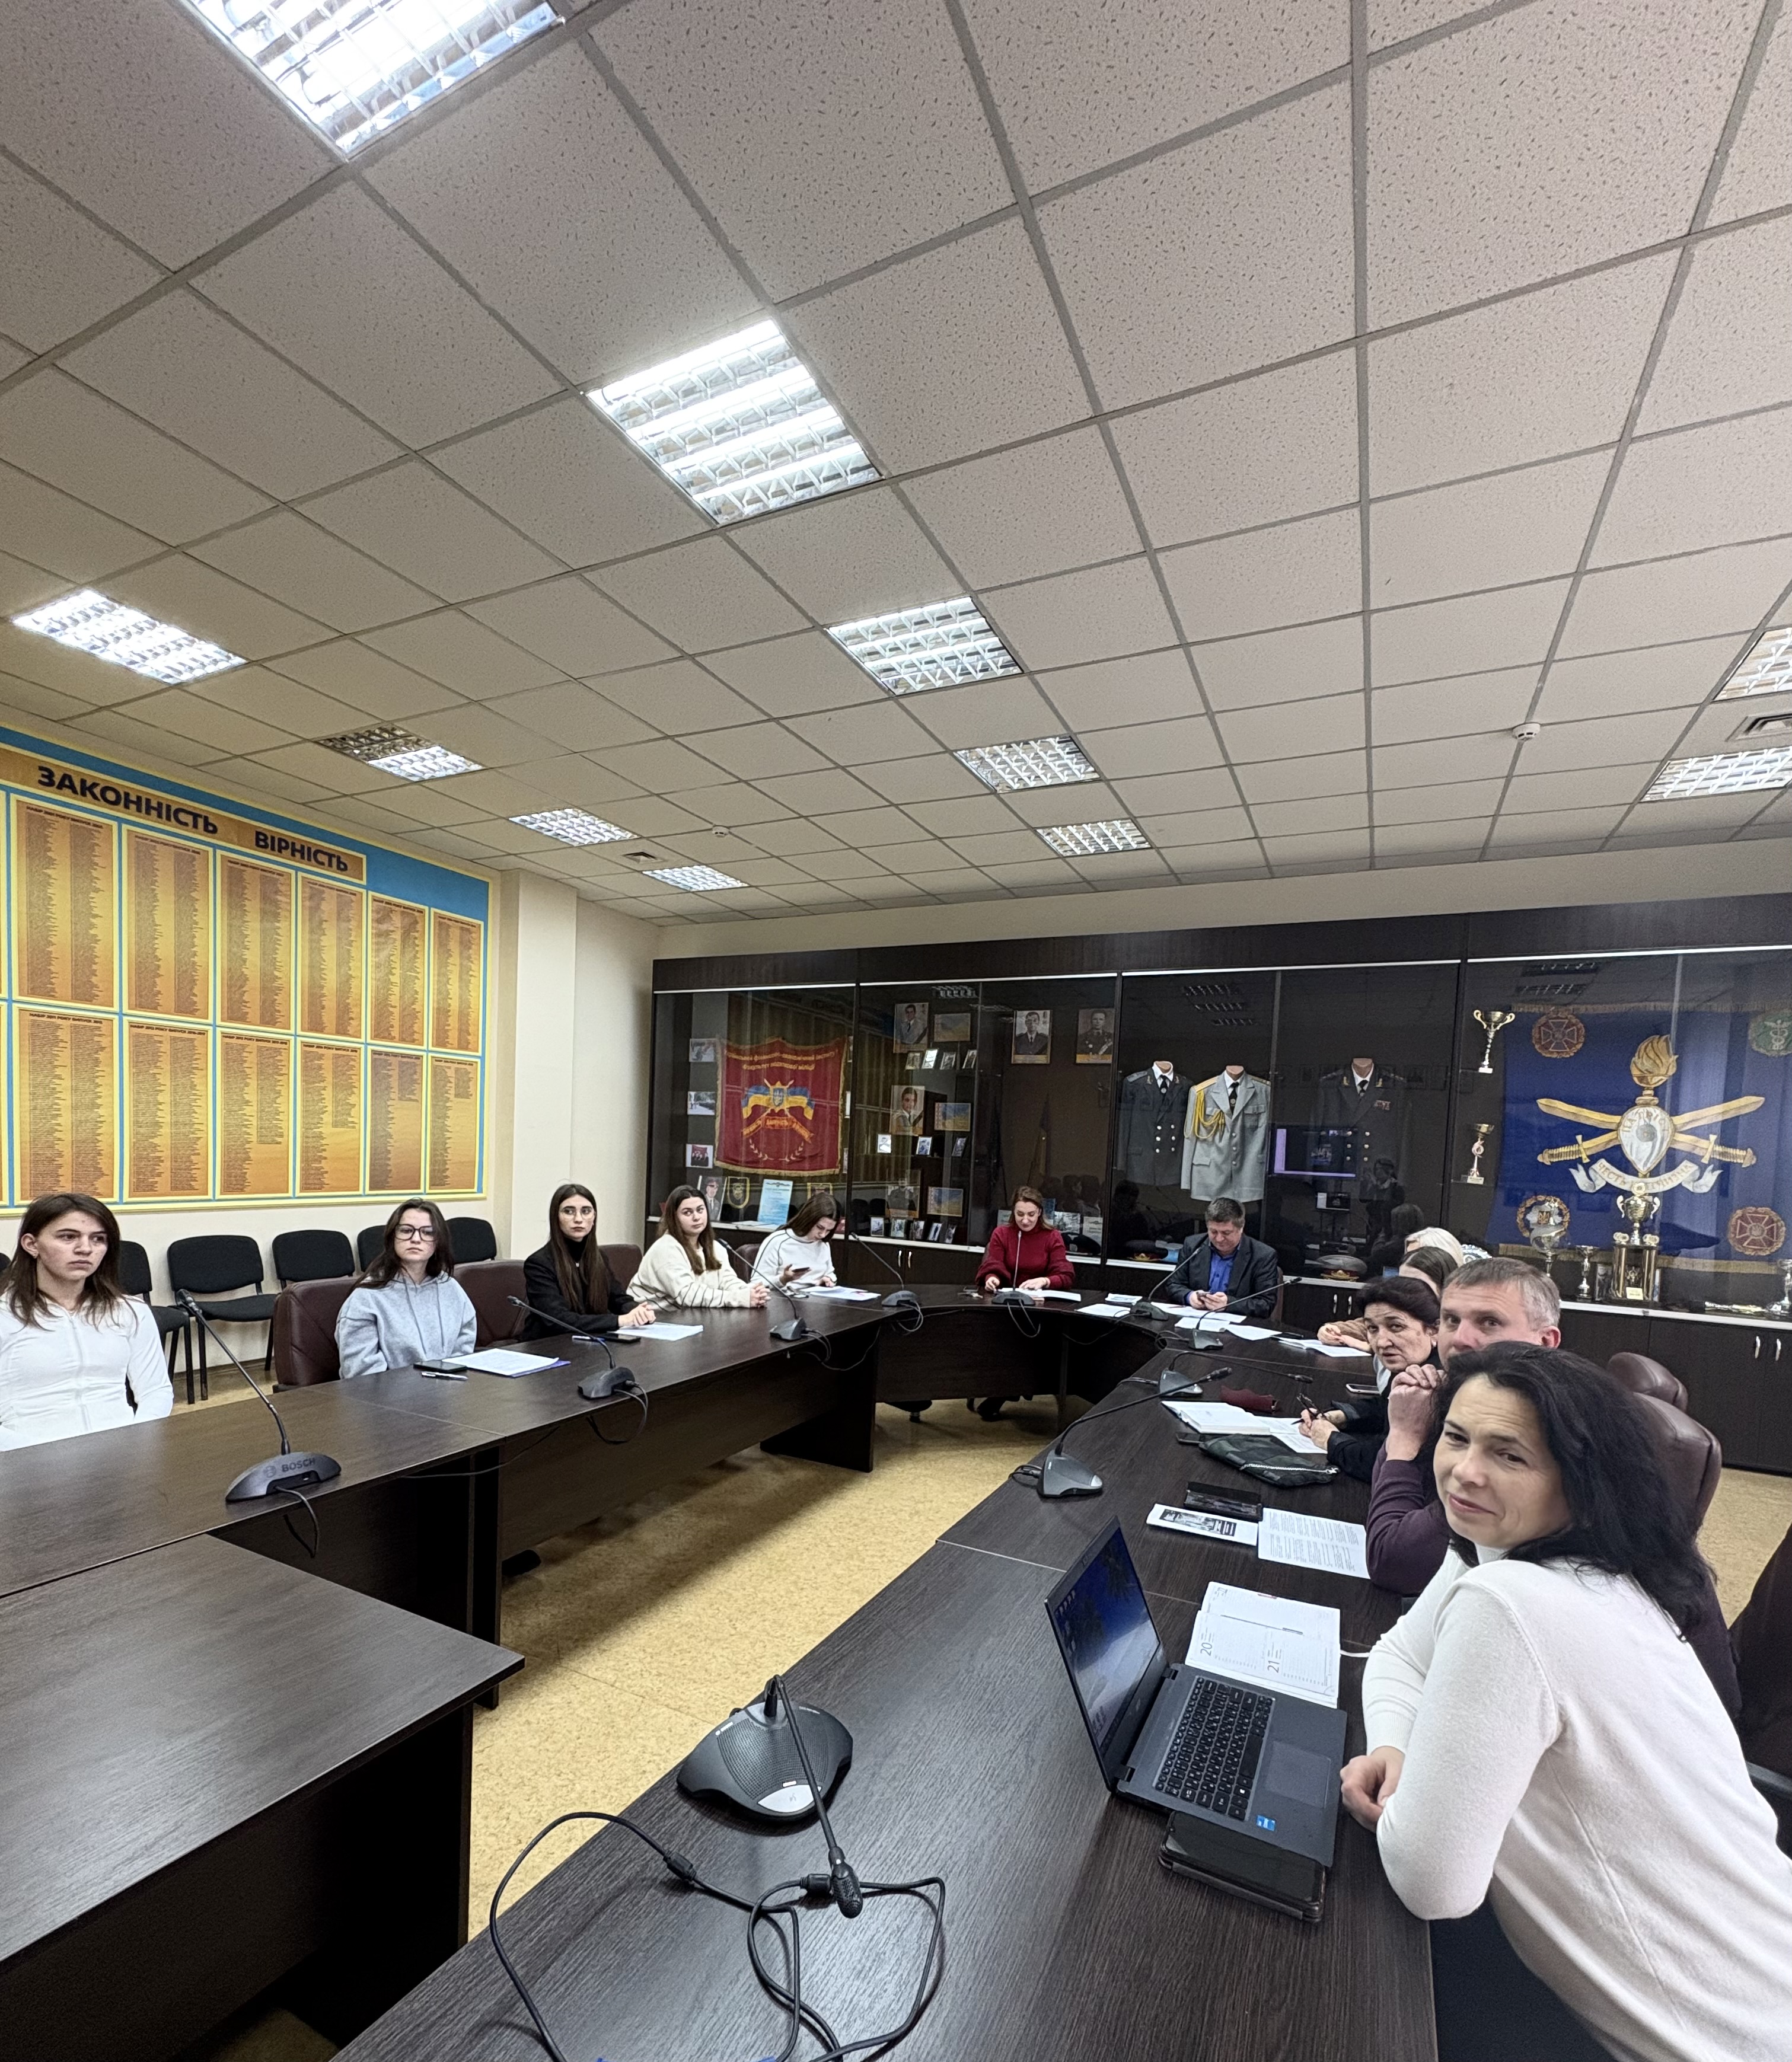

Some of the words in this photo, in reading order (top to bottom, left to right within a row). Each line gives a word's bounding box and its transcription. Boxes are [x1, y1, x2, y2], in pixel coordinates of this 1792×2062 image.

[37, 765, 218, 835] ЗАКОННІСТЬ
[255, 831, 349, 873] ВІРНІСТЬ
[1598, 1163, 1627, 1186] ЧЕСТЬ
[282, 1458, 315, 1473] BOSCH
[1200, 1642, 1213, 1656] 20
[1267, 1660, 1280, 1673] 21
